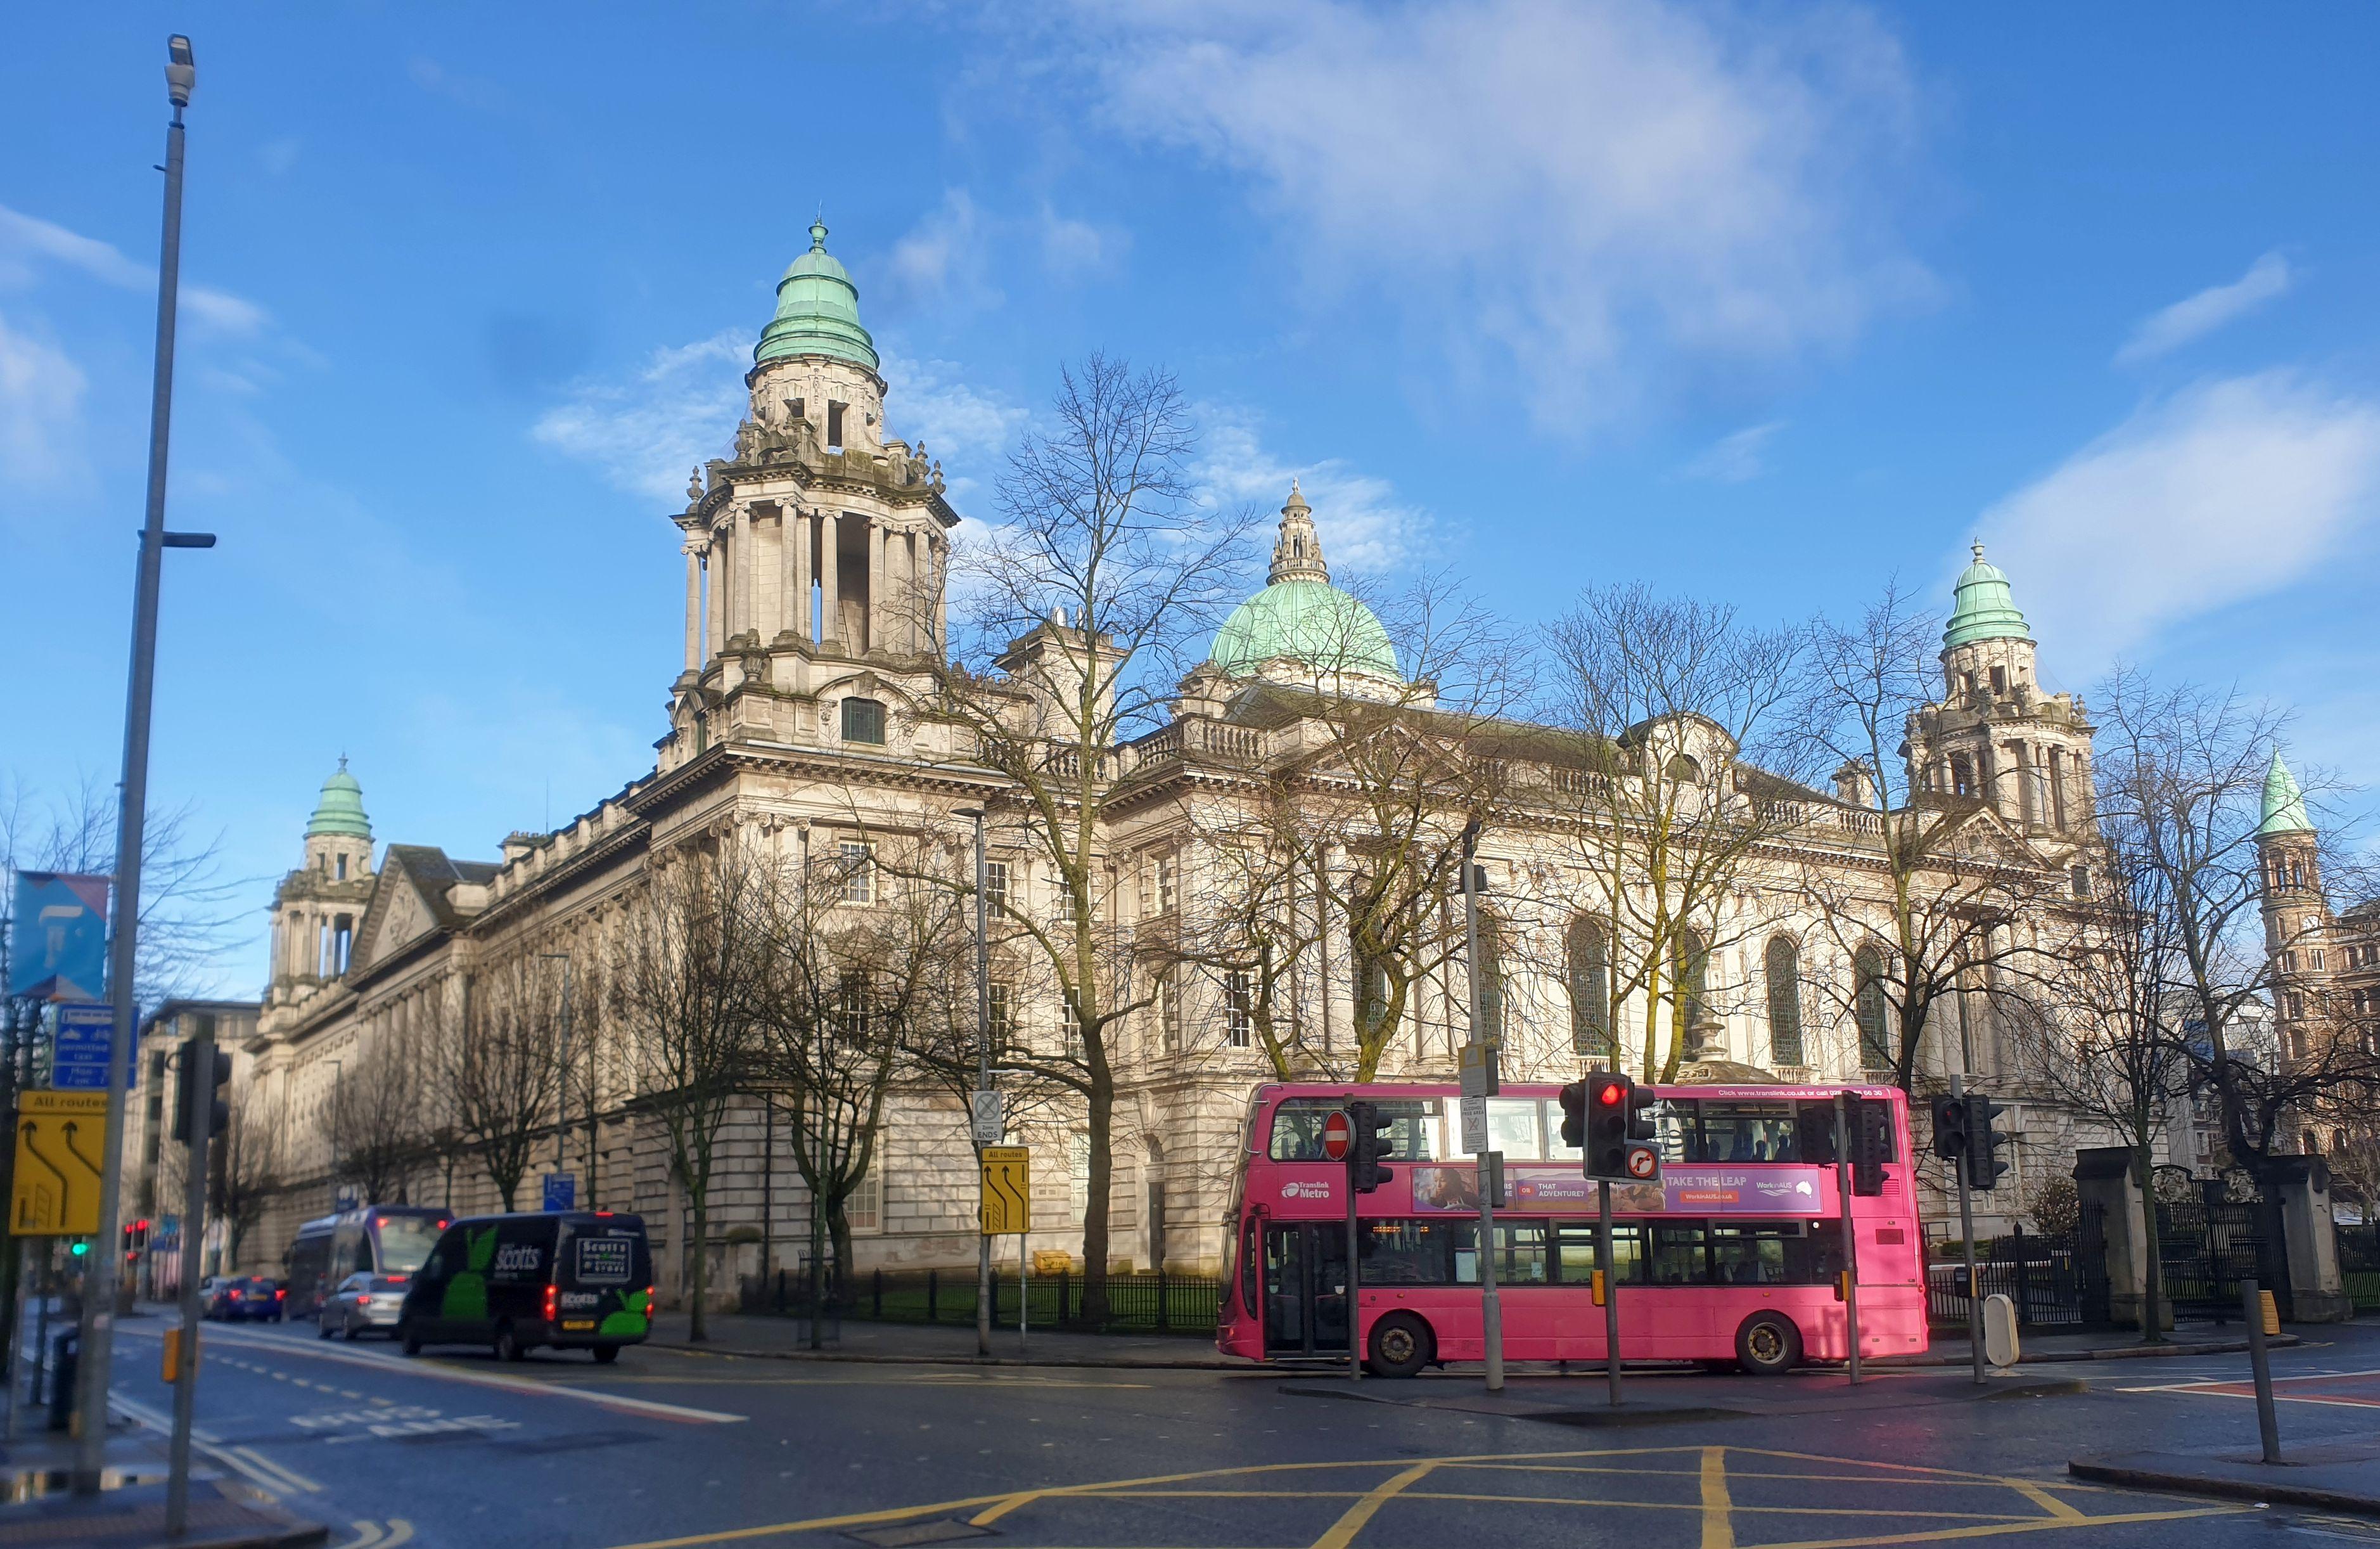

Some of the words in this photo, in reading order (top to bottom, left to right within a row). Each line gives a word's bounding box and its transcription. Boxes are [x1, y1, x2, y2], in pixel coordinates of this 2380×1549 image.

[34, 1096, 54, 1107] All
[1667, 1177, 1694, 1186] TAKE
[1696, 1177, 1718, 1186] THE
[1721, 1177, 1747, 1186] LEAP
[1300, 1189, 1329, 1198] Metro
